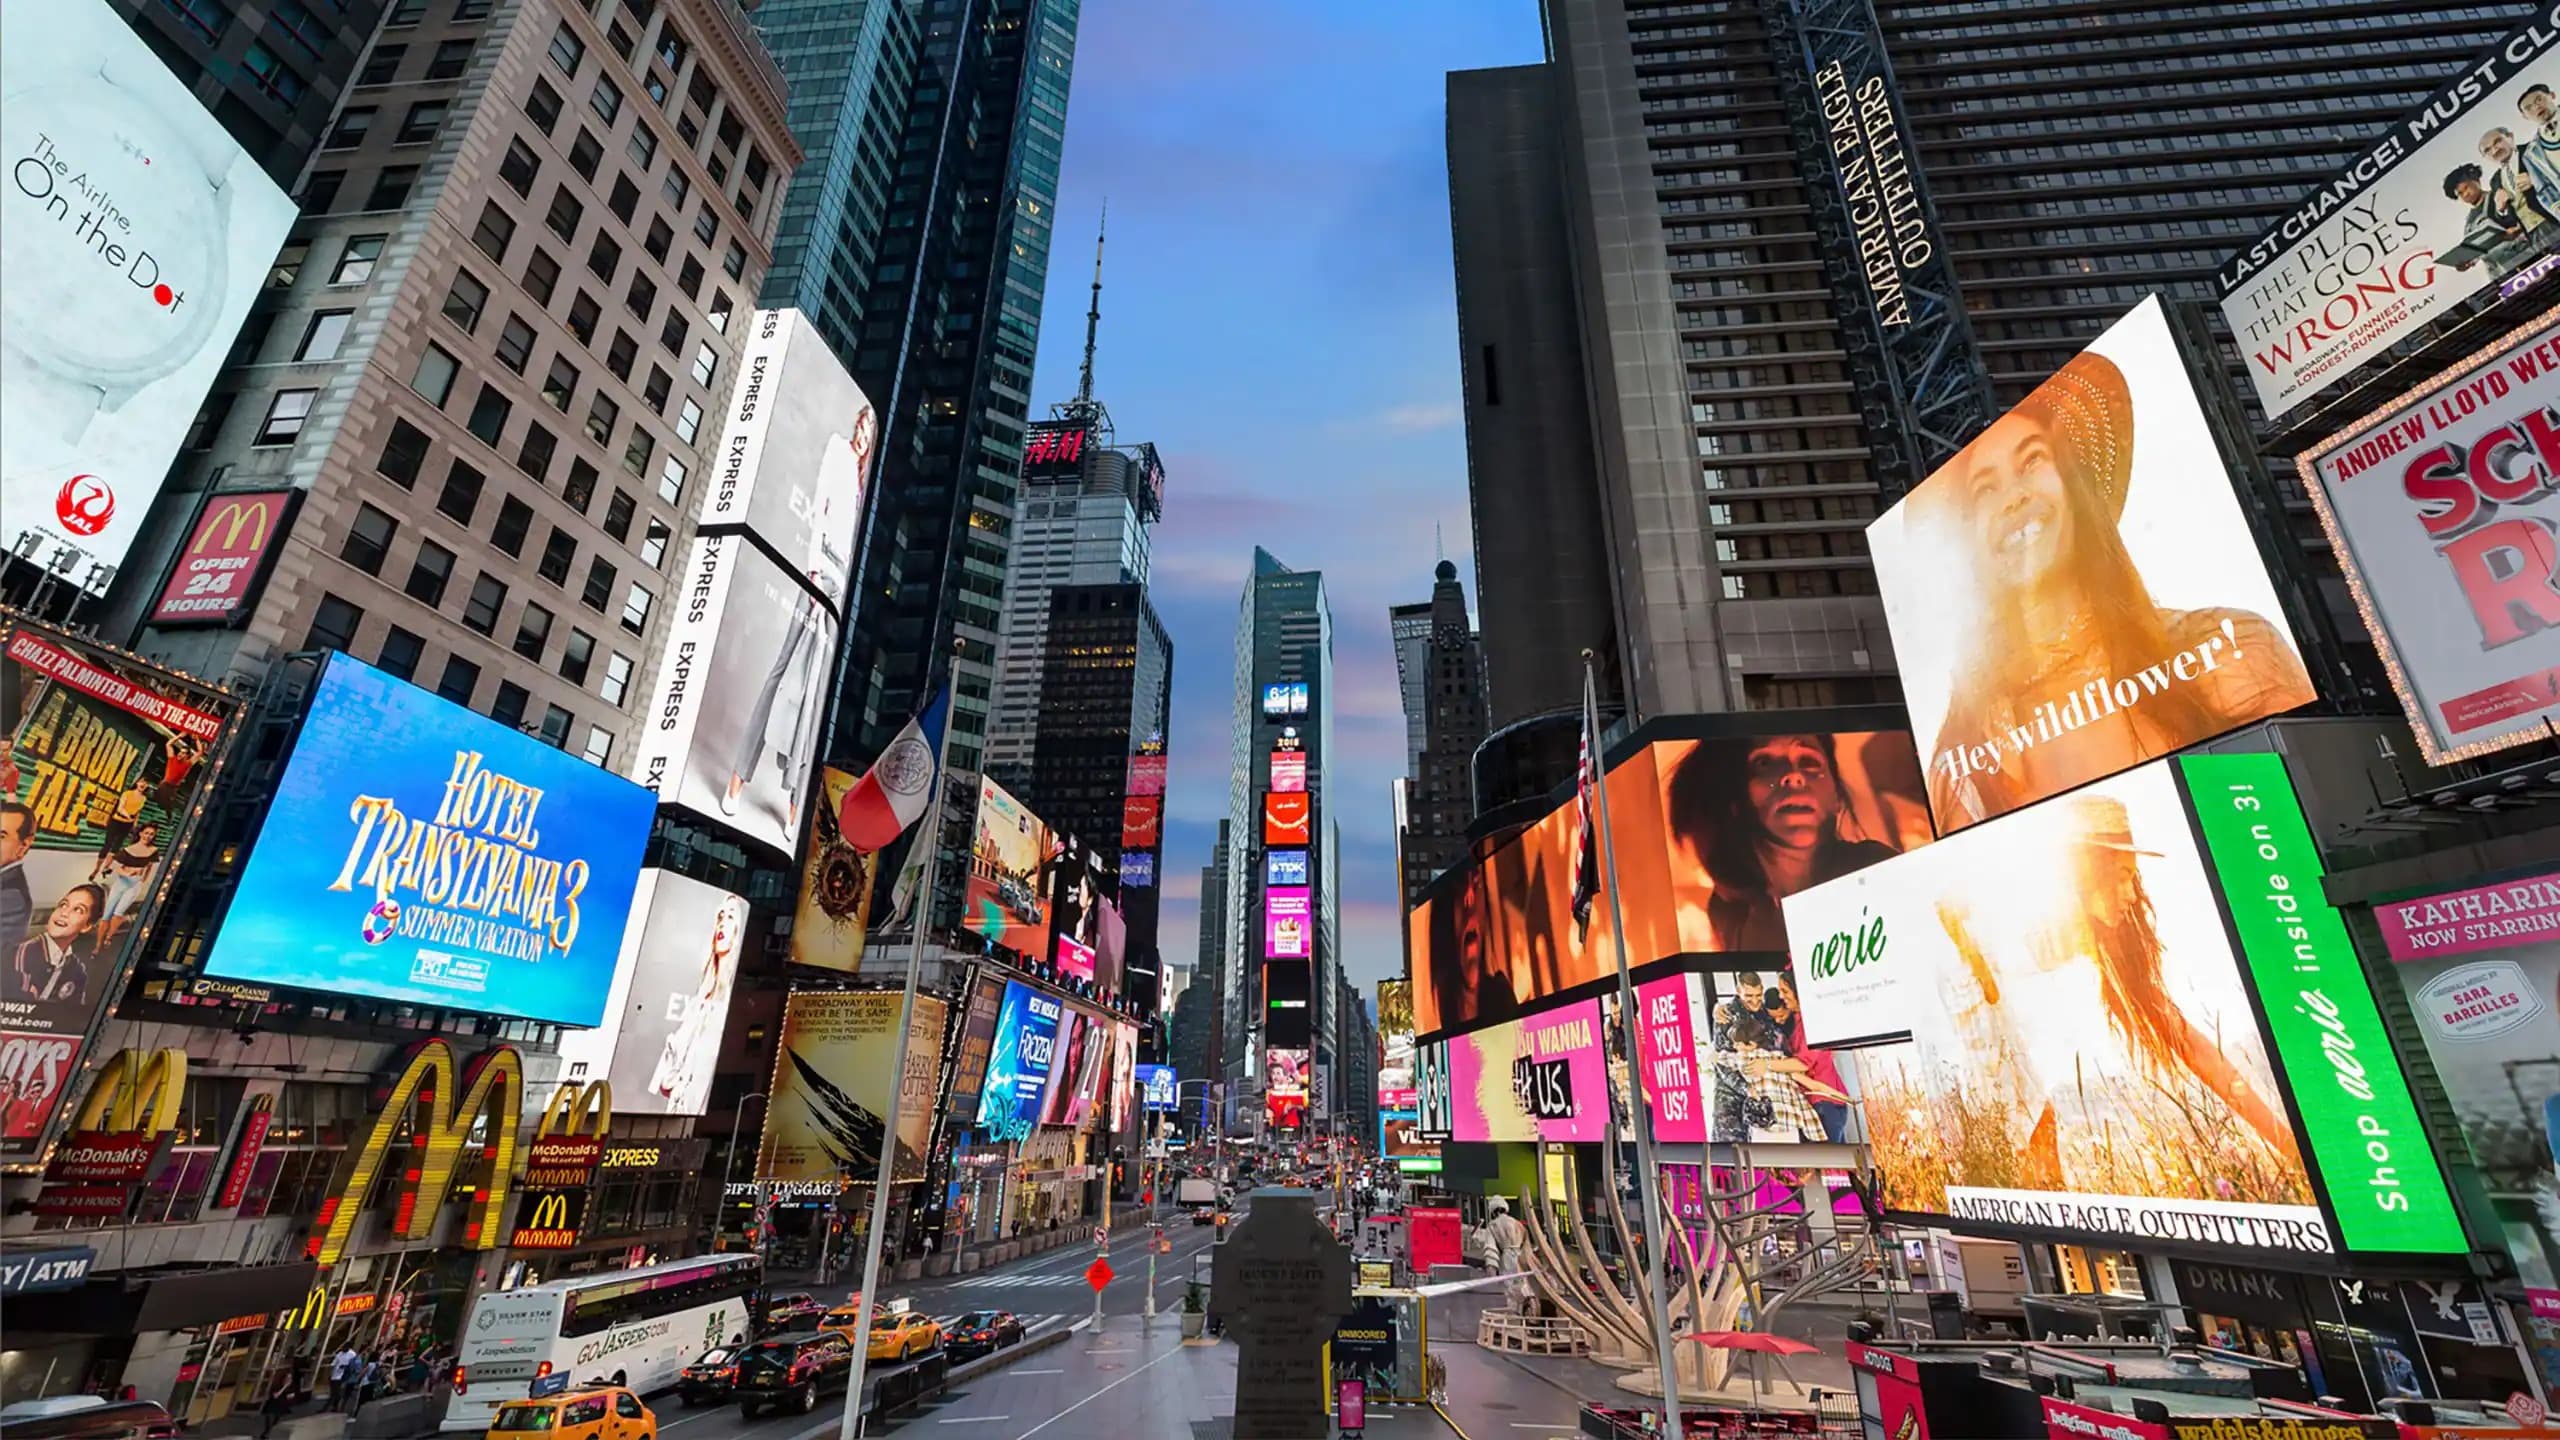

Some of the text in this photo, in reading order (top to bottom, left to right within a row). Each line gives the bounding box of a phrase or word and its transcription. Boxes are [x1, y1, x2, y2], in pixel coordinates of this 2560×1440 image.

[33, 132, 134, 236] The Airline,
[1855, 76, 1932, 269] OUTFITTERS
[2220, 232, 2281, 290] LAST
[2282, 136, 2405, 241] CHANCE!
[2408, 58, 2498, 143] MUST
[1815, 59, 1911, 328] AMERICAN EAGLE
[14, 157, 185, 314] On the Dot
[2246, 192, 2382, 311] THE PLAY
[2244, 208, 2419, 342] THAT GOES
[2254, 251, 2437, 377] WRONG
[2279, 293, 2437, 400] AND LONGEST-RUNNING PLAY
[2293, 297, 2408, 378] BROADWAY'S FUNNIEST
[740, 355, 768, 422] EXPRESS
[2428, 370, 2510, 431] LLOYD
[716, 435, 748, 513] EXPRESS
[62, 513, 95, 534] JAL
[183, 571, 234, 596] 24
[189, 556, 249, 572] OPEN
[688, 534, 723, 624] EXPRESS
[161, 597, 239, 613] HOURS
[11, 637, 220, 738] CHAZZ PALMINTERI JOINS THE CAST!
[660, 641, 697, 732] EXPRESS
[1940, 617, 2245, 783] Hey wildflower!
[24, 688, 141, 792] A BRONX
[24, 760, 97, 836] TALE
[434, 750, 544, 850] HOTEL
[2229, 782, 2261, 812] 3!
[2247, 821, 2279, 861] on
[327, 793, 590, 957] TRANSYLVANIA 3
[1281, 862, 1306, 873] TDK
[398, 905, 546, 963] SUMMER VACATION
[2266, 872, 2321, 973] inside
[2408, 926, 2457, 949] NOW
[1811, 905, 1887, 981] aerie
[0, 1001, 37, 1014] WAY
[793, 1008, 827, 1018] NEVER
[829, 1008, 842, 1018] BE
[844, 1008, 864, 1018] THE
[804, 998, 890, 1008] BROADWAY WILL
[1651, 993, 1679, 1025] ARE
[2443, 992, 2520, 1025] BAREILLES
[2453, 985, 2492, 1006] SARA
[1016, 1024, 1056, 1069] FROZEN
[1537, 1018, 1593, 1056] WANNA
[1652, 1025, 1682, 1057] YOU
[2293, 987, 2376, 1102] aerie
[1536, 1064, 1572, 1117] US.
[1653, 1057, 1692, 1089] WITH
[1662, 1090, 1690, 1121] US?
[56, 1146, 148, 1163] McDonald's
[531, 1144, 600, 1156] McDonald's
[540, 1156, 586, 1164] Restaurant
[601, 1147, 661, 1168] EXPRESS
[62, 1164, 127, 1177] Restaurant
[723, 1182, 760, 1196] GIFTS
[84, 1195, 123, 1207] HOURS
[1950, 1196, 2330, 1254] AMERICAN EAGLE OUTFITTERS
[0, 1257, 89, 1291] Y/ATM
[2188, 1268, 2284, 1302] DRINK
[1337, 1329, 1388, 1340] UNMOORED
[2049, 1407, 2098, 1436] belgian
[2174, 1417, 2367, 1440] wafels&dinges
